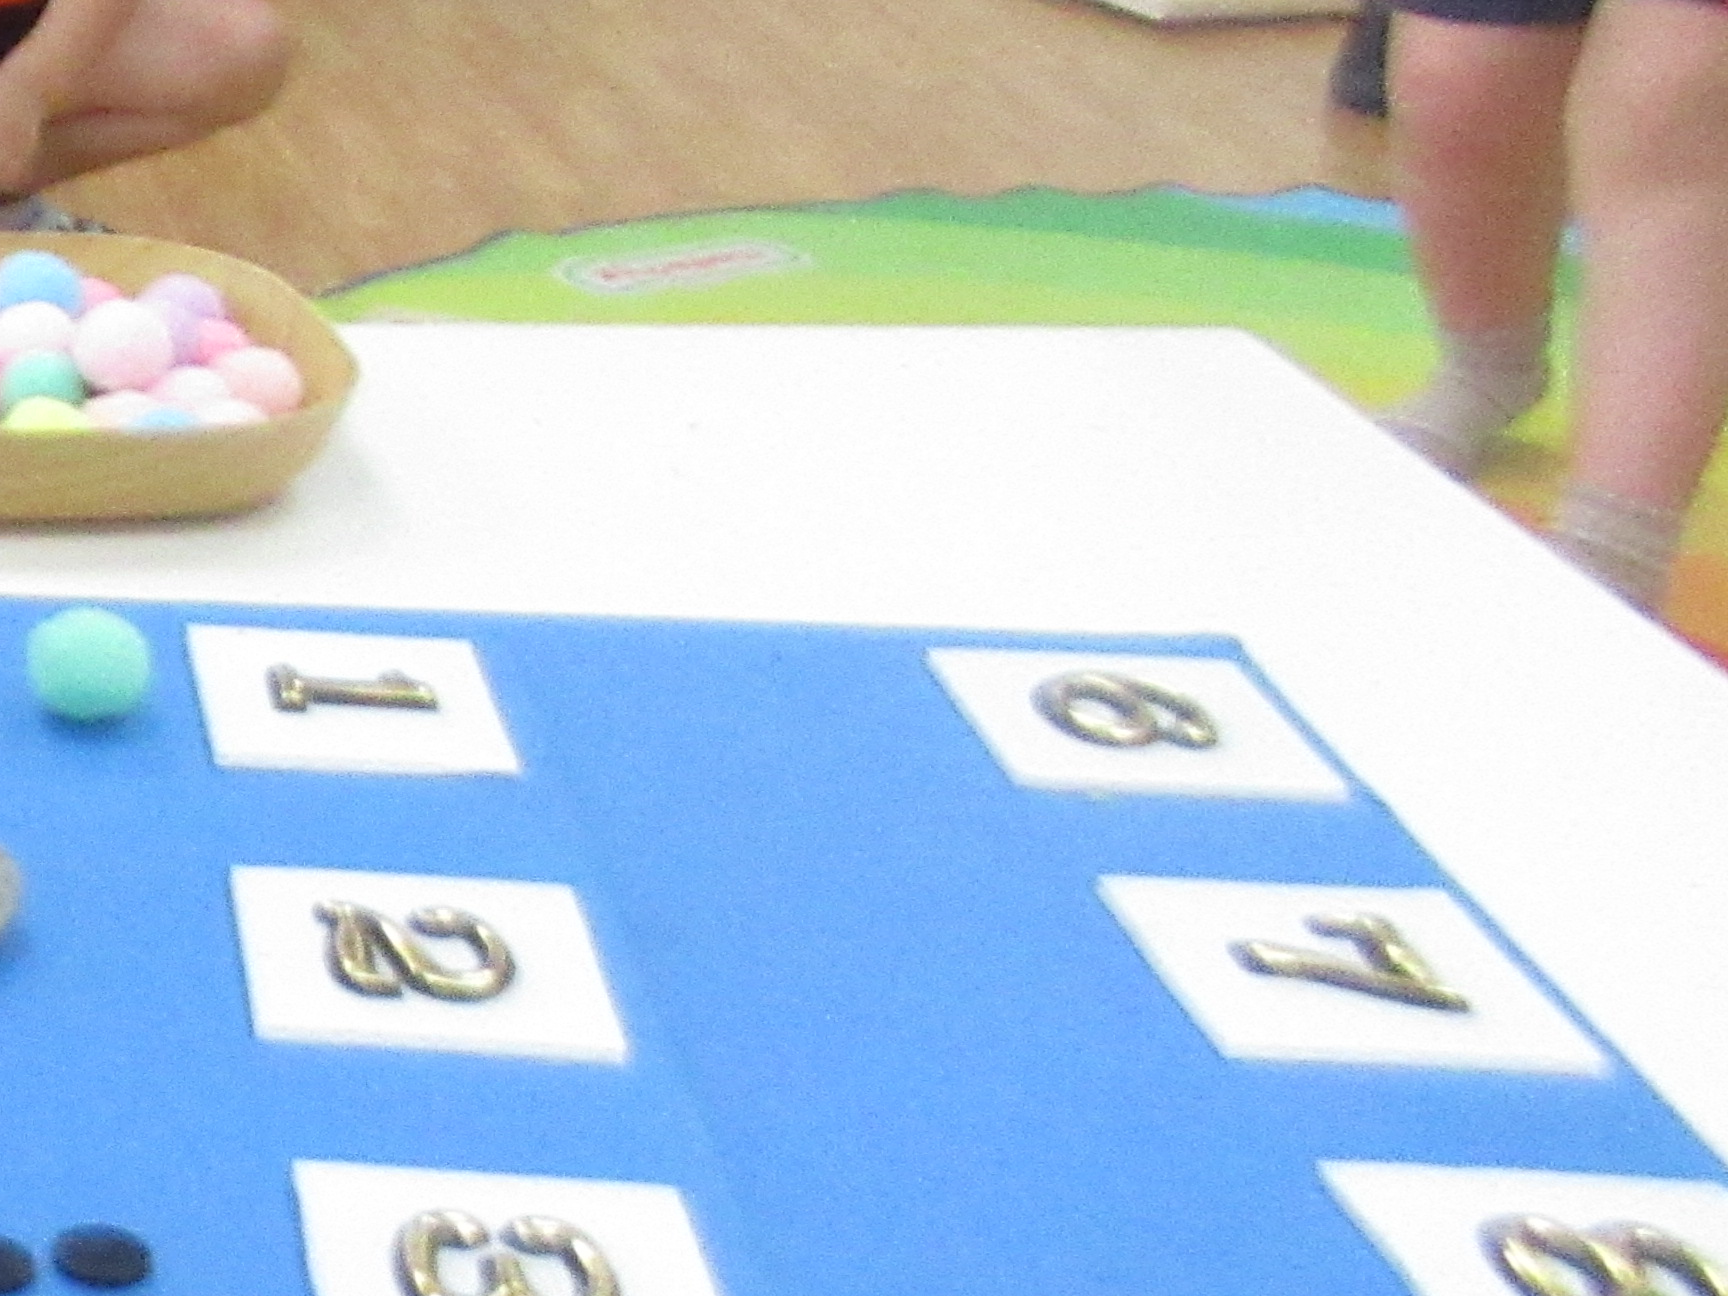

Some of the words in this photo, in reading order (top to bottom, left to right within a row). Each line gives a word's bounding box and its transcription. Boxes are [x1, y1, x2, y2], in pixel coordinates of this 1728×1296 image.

[265, 662, 439, 713] 1
[1030, 669, 1220, 750] 6
[312, 899, 516, 1004] 2
[1226, 910, 1474, 1015] 7
